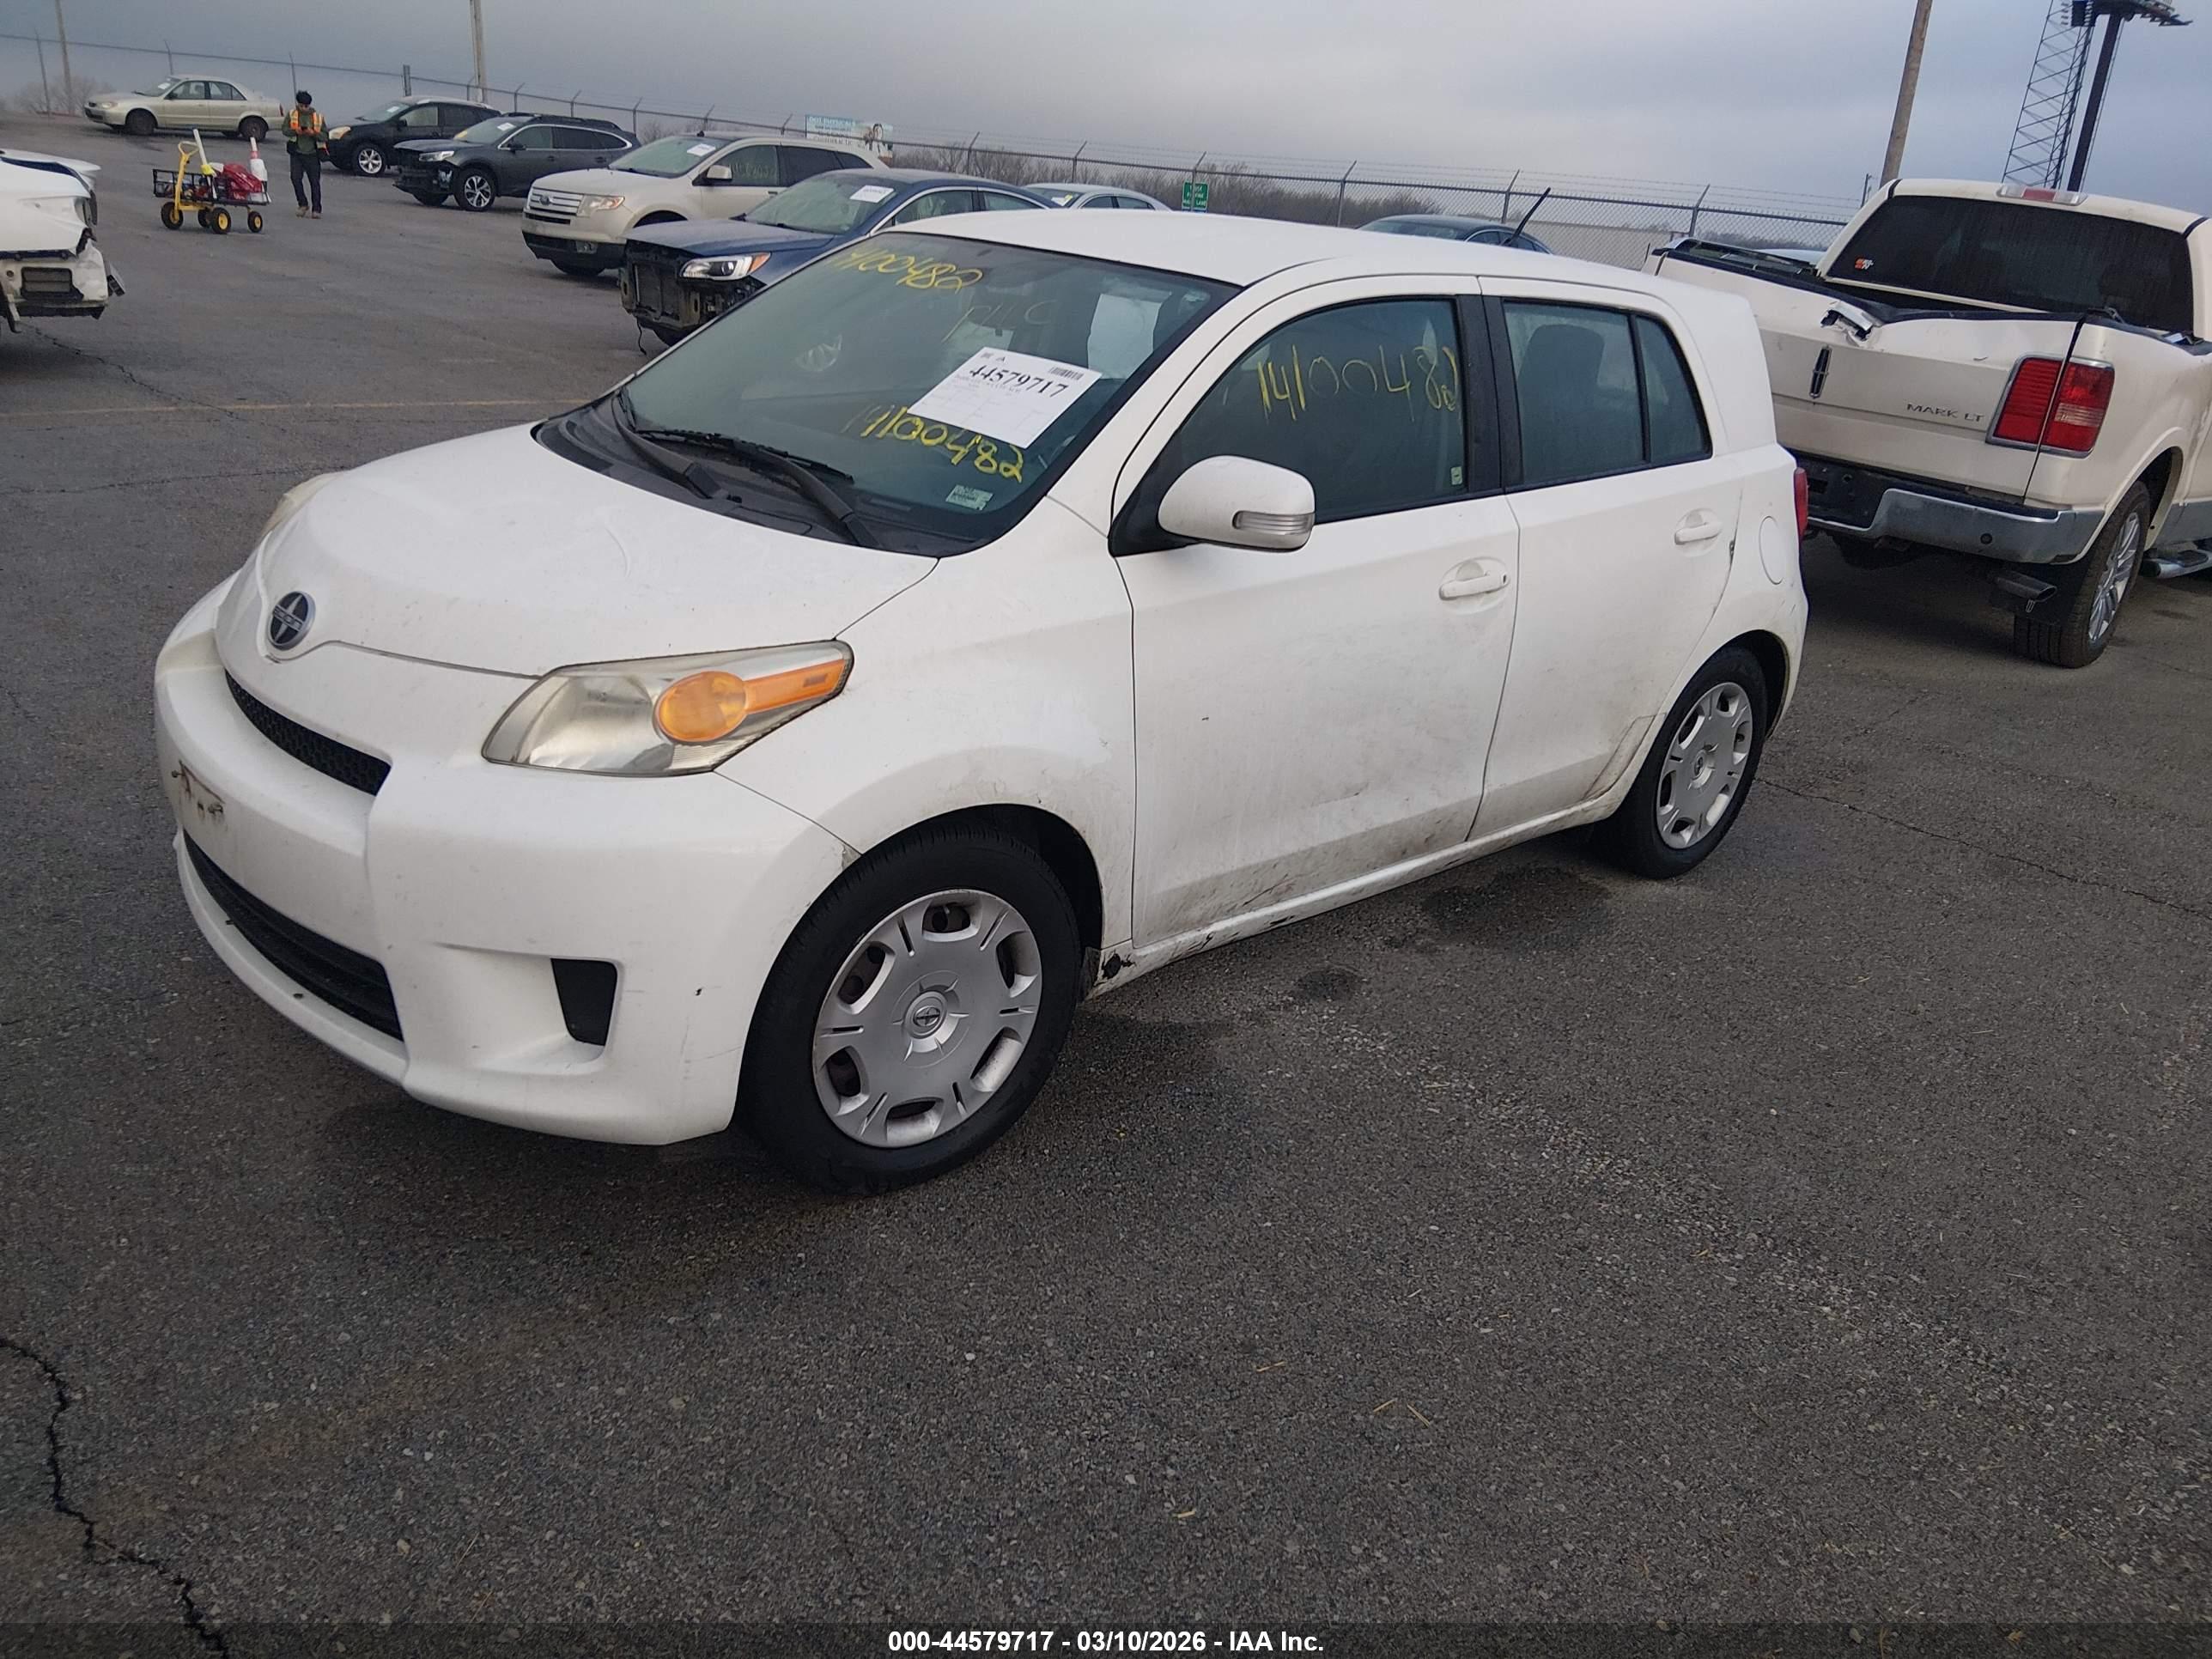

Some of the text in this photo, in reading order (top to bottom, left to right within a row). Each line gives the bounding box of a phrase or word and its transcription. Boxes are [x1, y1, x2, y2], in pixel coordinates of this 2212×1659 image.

[969, 365, 1069, 398] 44579717
[1906, 404, 1985, 422] MARK LT
